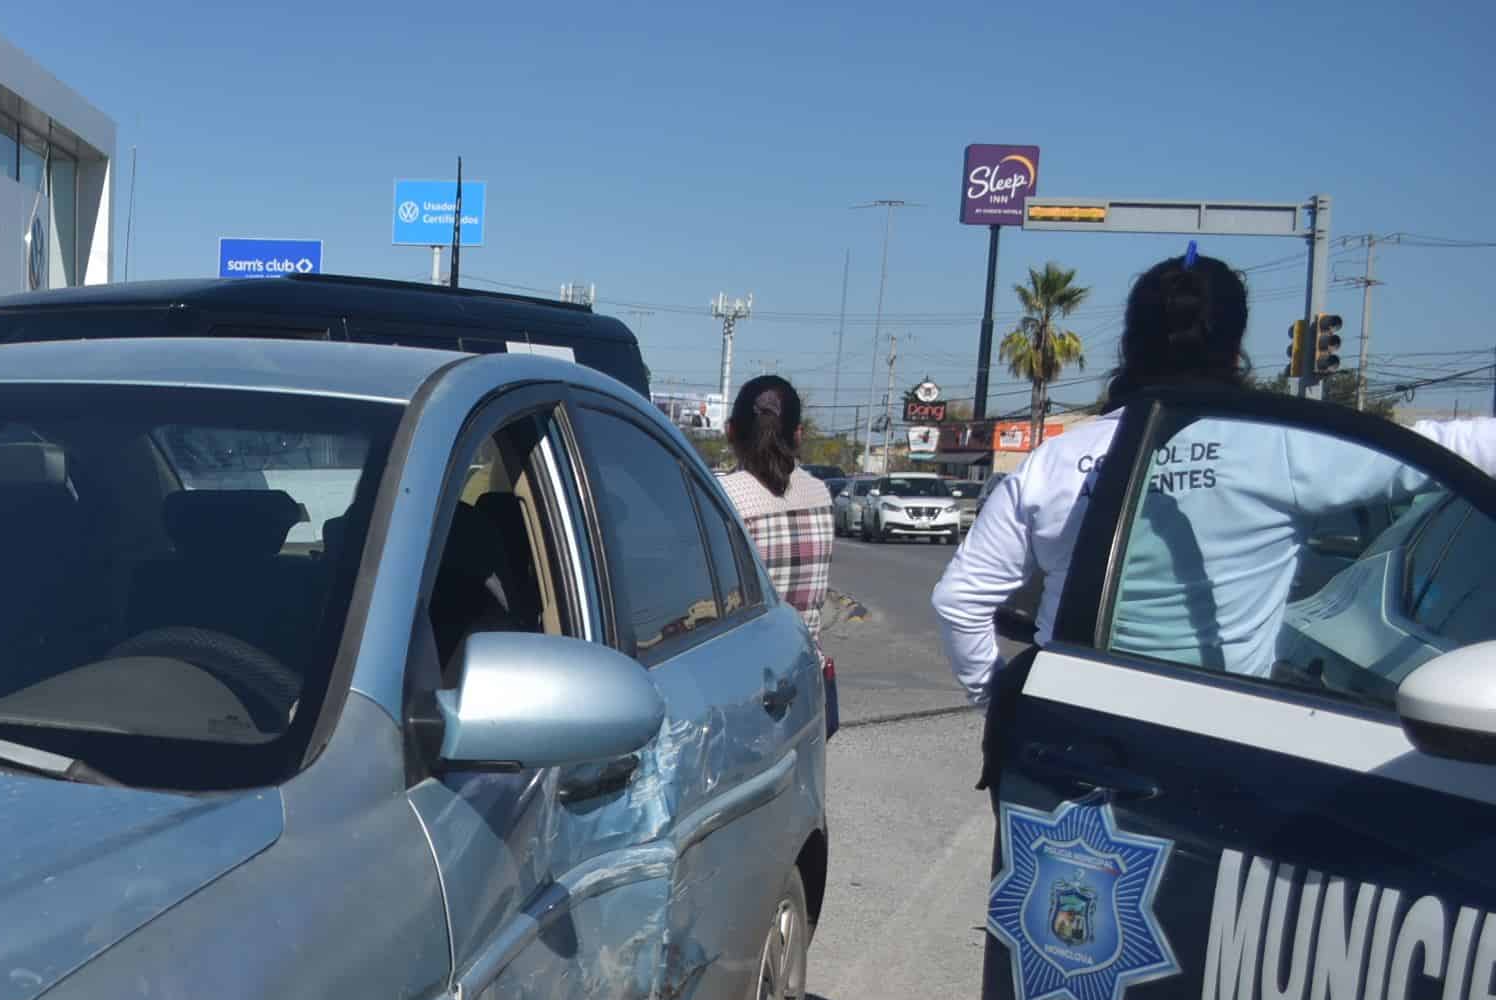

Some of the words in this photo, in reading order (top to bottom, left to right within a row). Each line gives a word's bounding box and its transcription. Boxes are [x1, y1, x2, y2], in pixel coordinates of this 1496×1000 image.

[967, 164, 1028, 199] Sleep
[989, 195, 1009, 204] INN
[227, 259, 264, 272] sam's
[265, 258, 294, 272] club
[1191, 442, 1220, 461] DE
